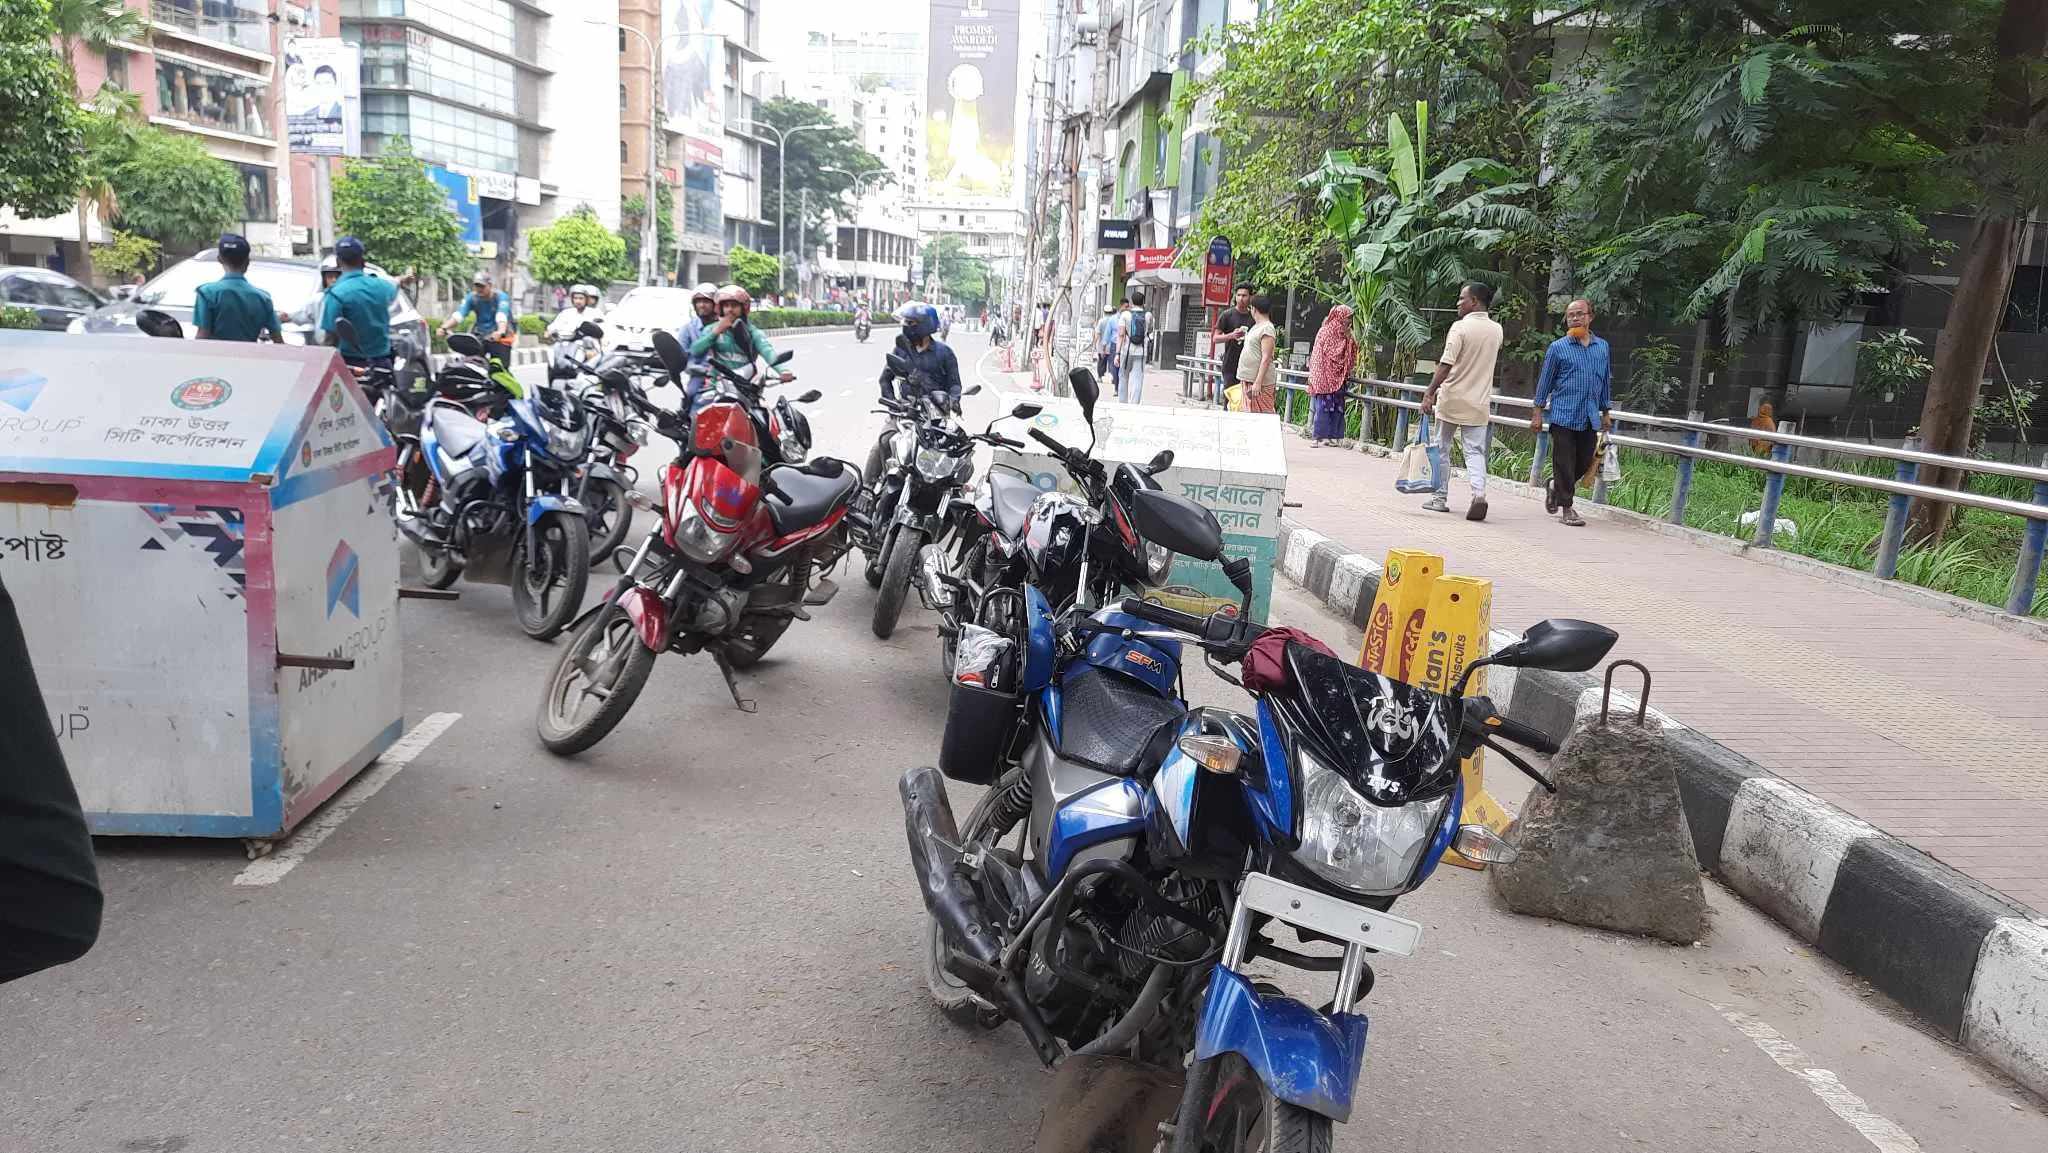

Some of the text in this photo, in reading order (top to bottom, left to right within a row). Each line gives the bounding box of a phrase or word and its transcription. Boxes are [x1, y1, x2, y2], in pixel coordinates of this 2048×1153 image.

[0, 417, 81, 433] ROUP
[139, 415, 231, 431] ঢাকা উত্তর
[104, 427, 248, 449] সিটি কর্পোরেশন
[1180, 482, 1265, 507] সাবধানে
